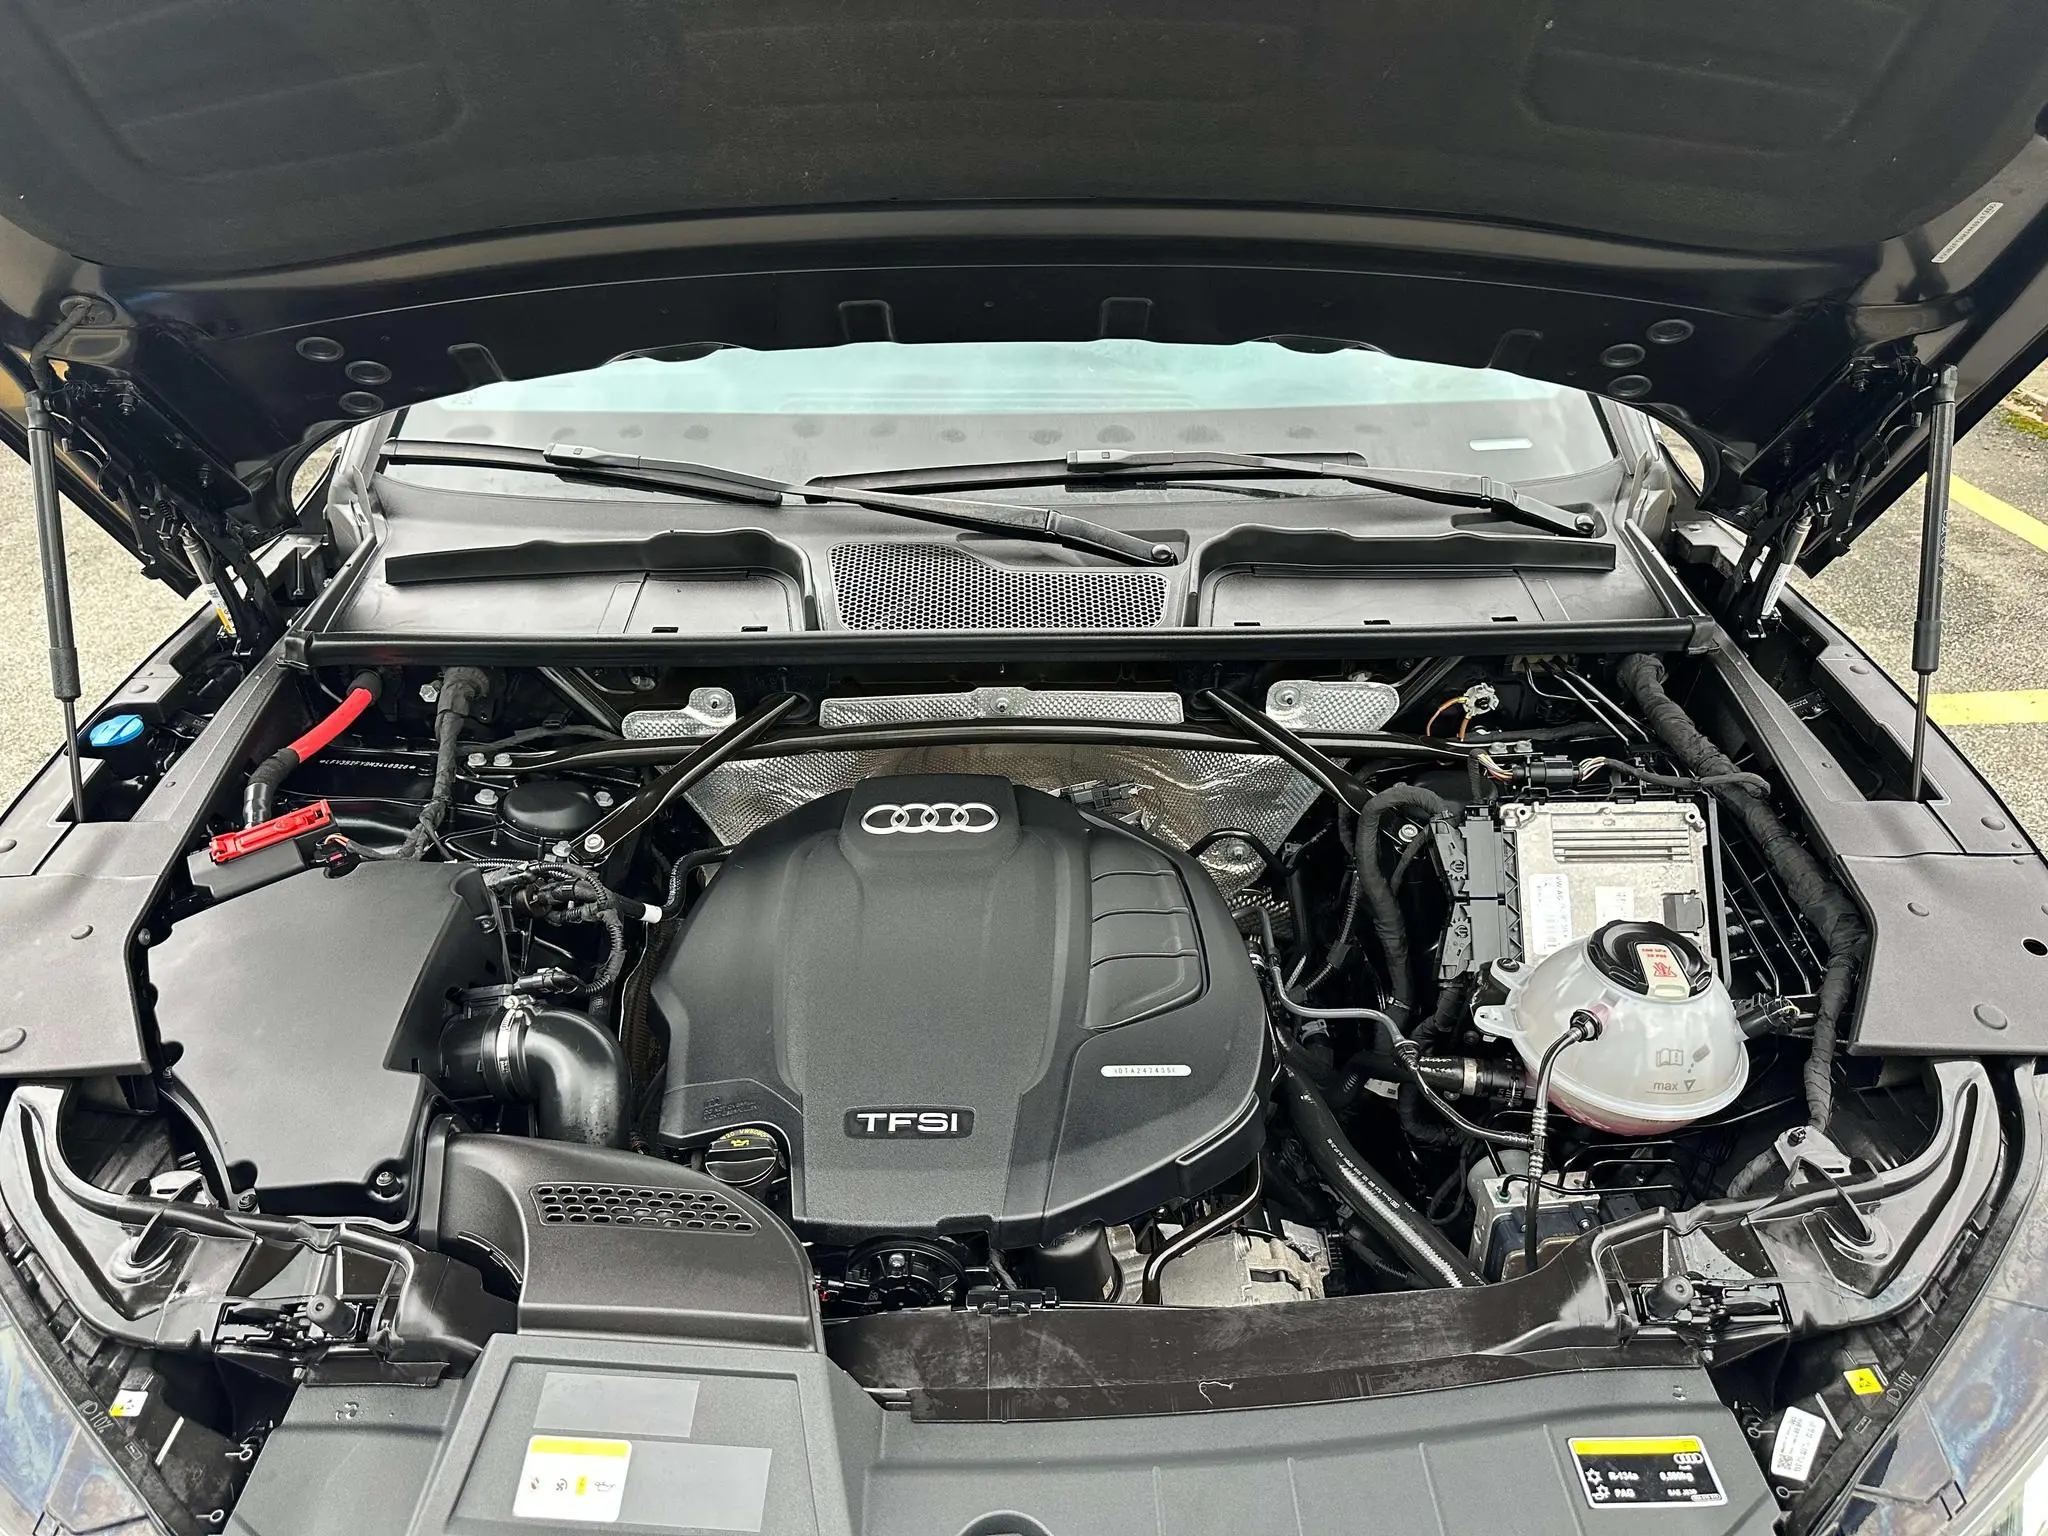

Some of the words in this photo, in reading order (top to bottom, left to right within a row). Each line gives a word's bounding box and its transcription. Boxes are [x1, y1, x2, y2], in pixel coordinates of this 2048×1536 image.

[1653, 1081, 1678, 1091] max
[857, 1113, 958, 1132] TFSI
[1893, 1369, 1918, 1392] 10%
[89, 1411, 115, 1434] 10%
